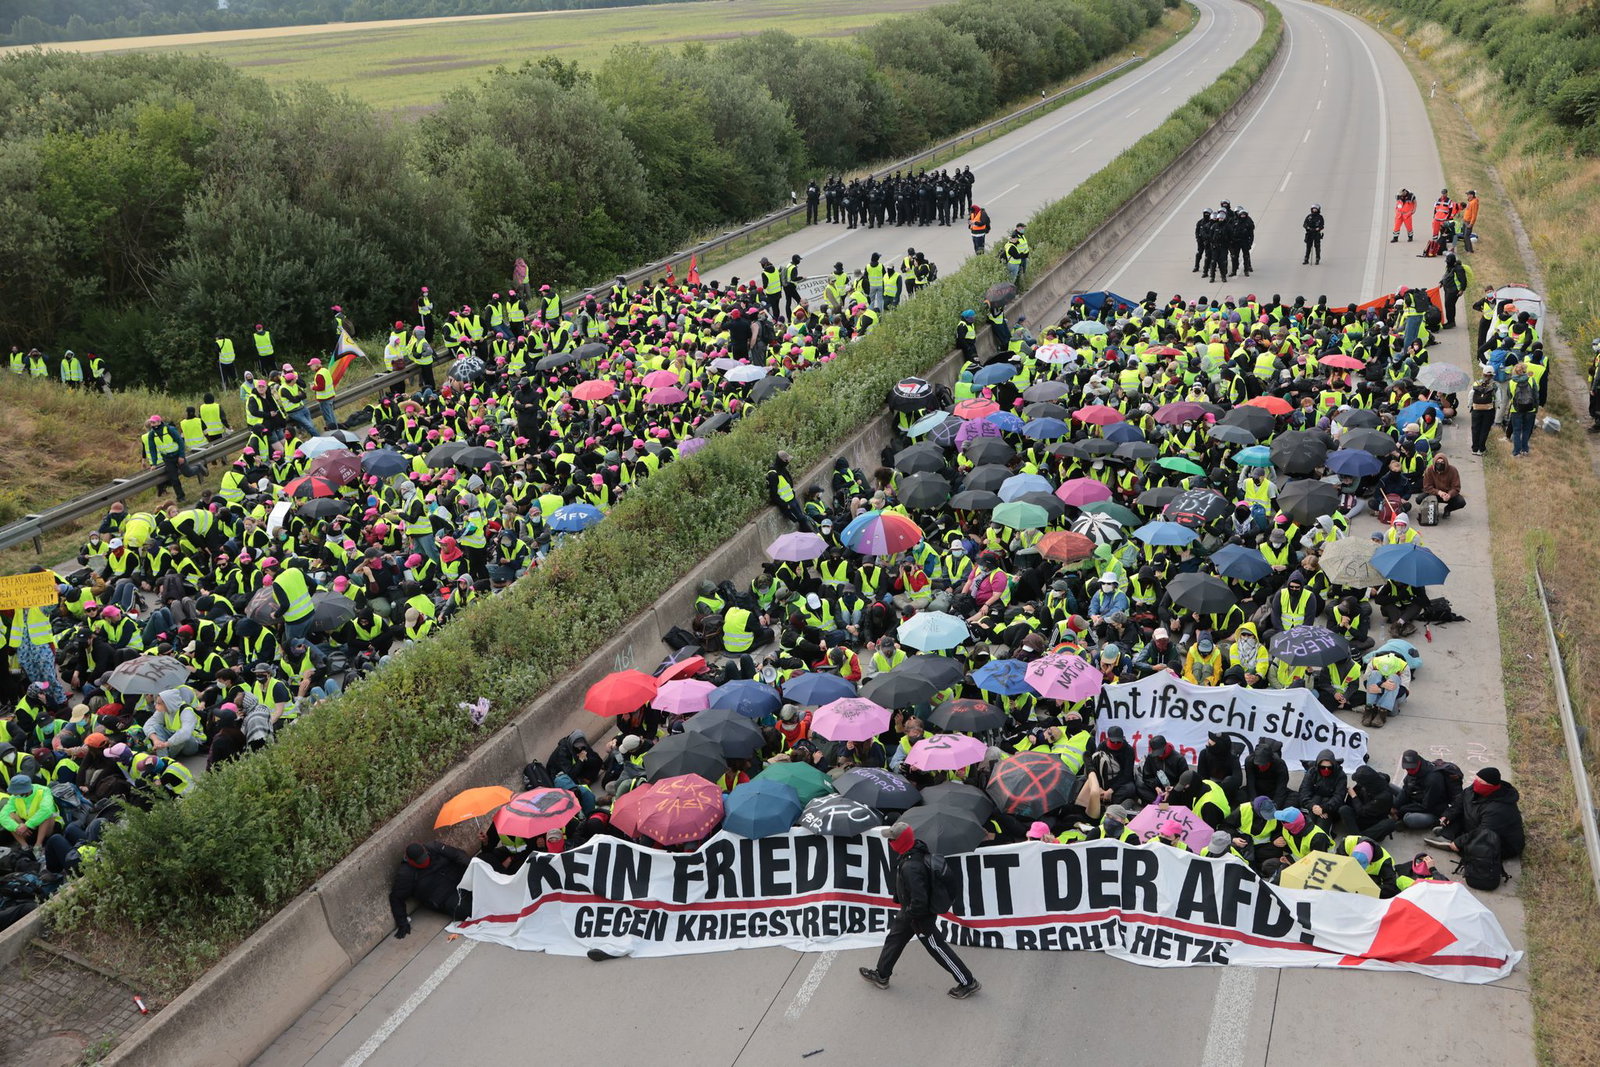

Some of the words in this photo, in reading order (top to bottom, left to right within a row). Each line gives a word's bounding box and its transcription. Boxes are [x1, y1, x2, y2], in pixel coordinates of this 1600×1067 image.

[613, 644, 635, 673] 161
[526, 842, 652, 902] KEIN
[672, 834, 898, 903] FRIEDEN
[1042, 847, 1160, 913] DER
[1175, 859, 1316, 946] AFD!
[574, 905, 667, 942] GEGEN
[1130, 925, 1233, 966] HETZE
